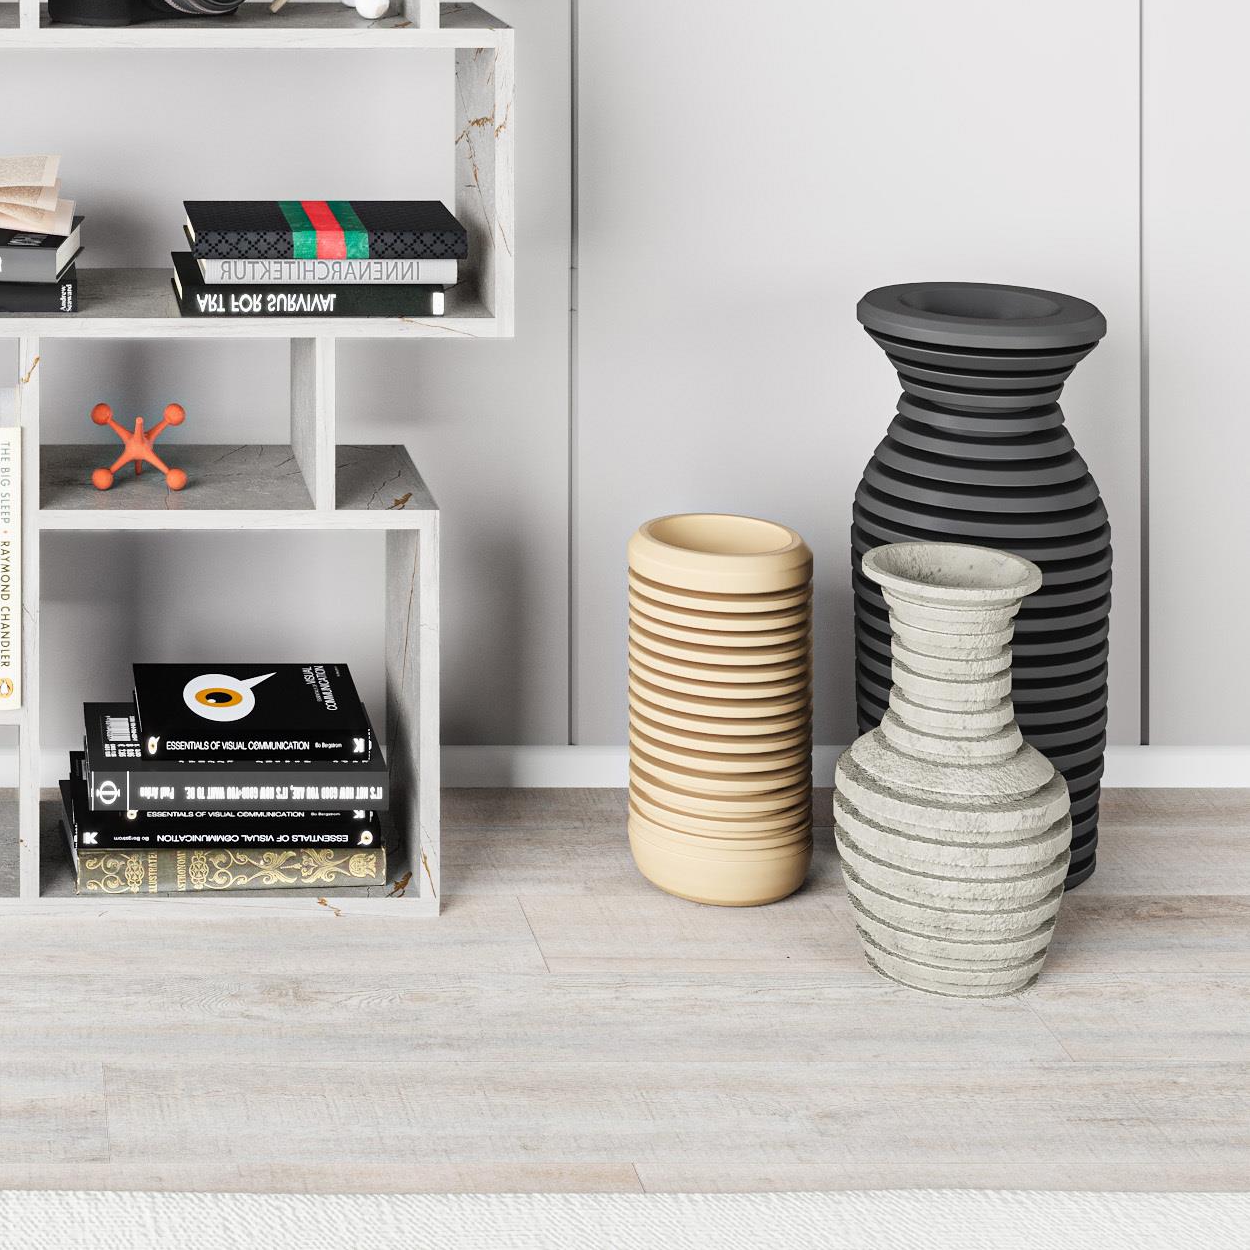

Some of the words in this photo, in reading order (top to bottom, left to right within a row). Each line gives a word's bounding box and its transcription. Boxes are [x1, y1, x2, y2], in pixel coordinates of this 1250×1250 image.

[0, 442, 10, 462] THE
[0, 468, 10, 487] BIG
[0, 492, 10, 524] SLEEP
[0, 540, 10, 601] RAYMOND
[0, 606, 11, 667] CHANDLER
[166, 741, 209, 751] ESSENTIALS
[210, 741, 221, 751] OF
[222, 741, 247, 751] VISUAL
[248, 741, 310, 751] COMMUNICATION
[156, 834, 240, 843] COMMUNICATION
[241, 834, 275, 842] VISUAL
[276, 834, 290, 842] OF
[291, 834, 349, 842] ESSENTIALS
